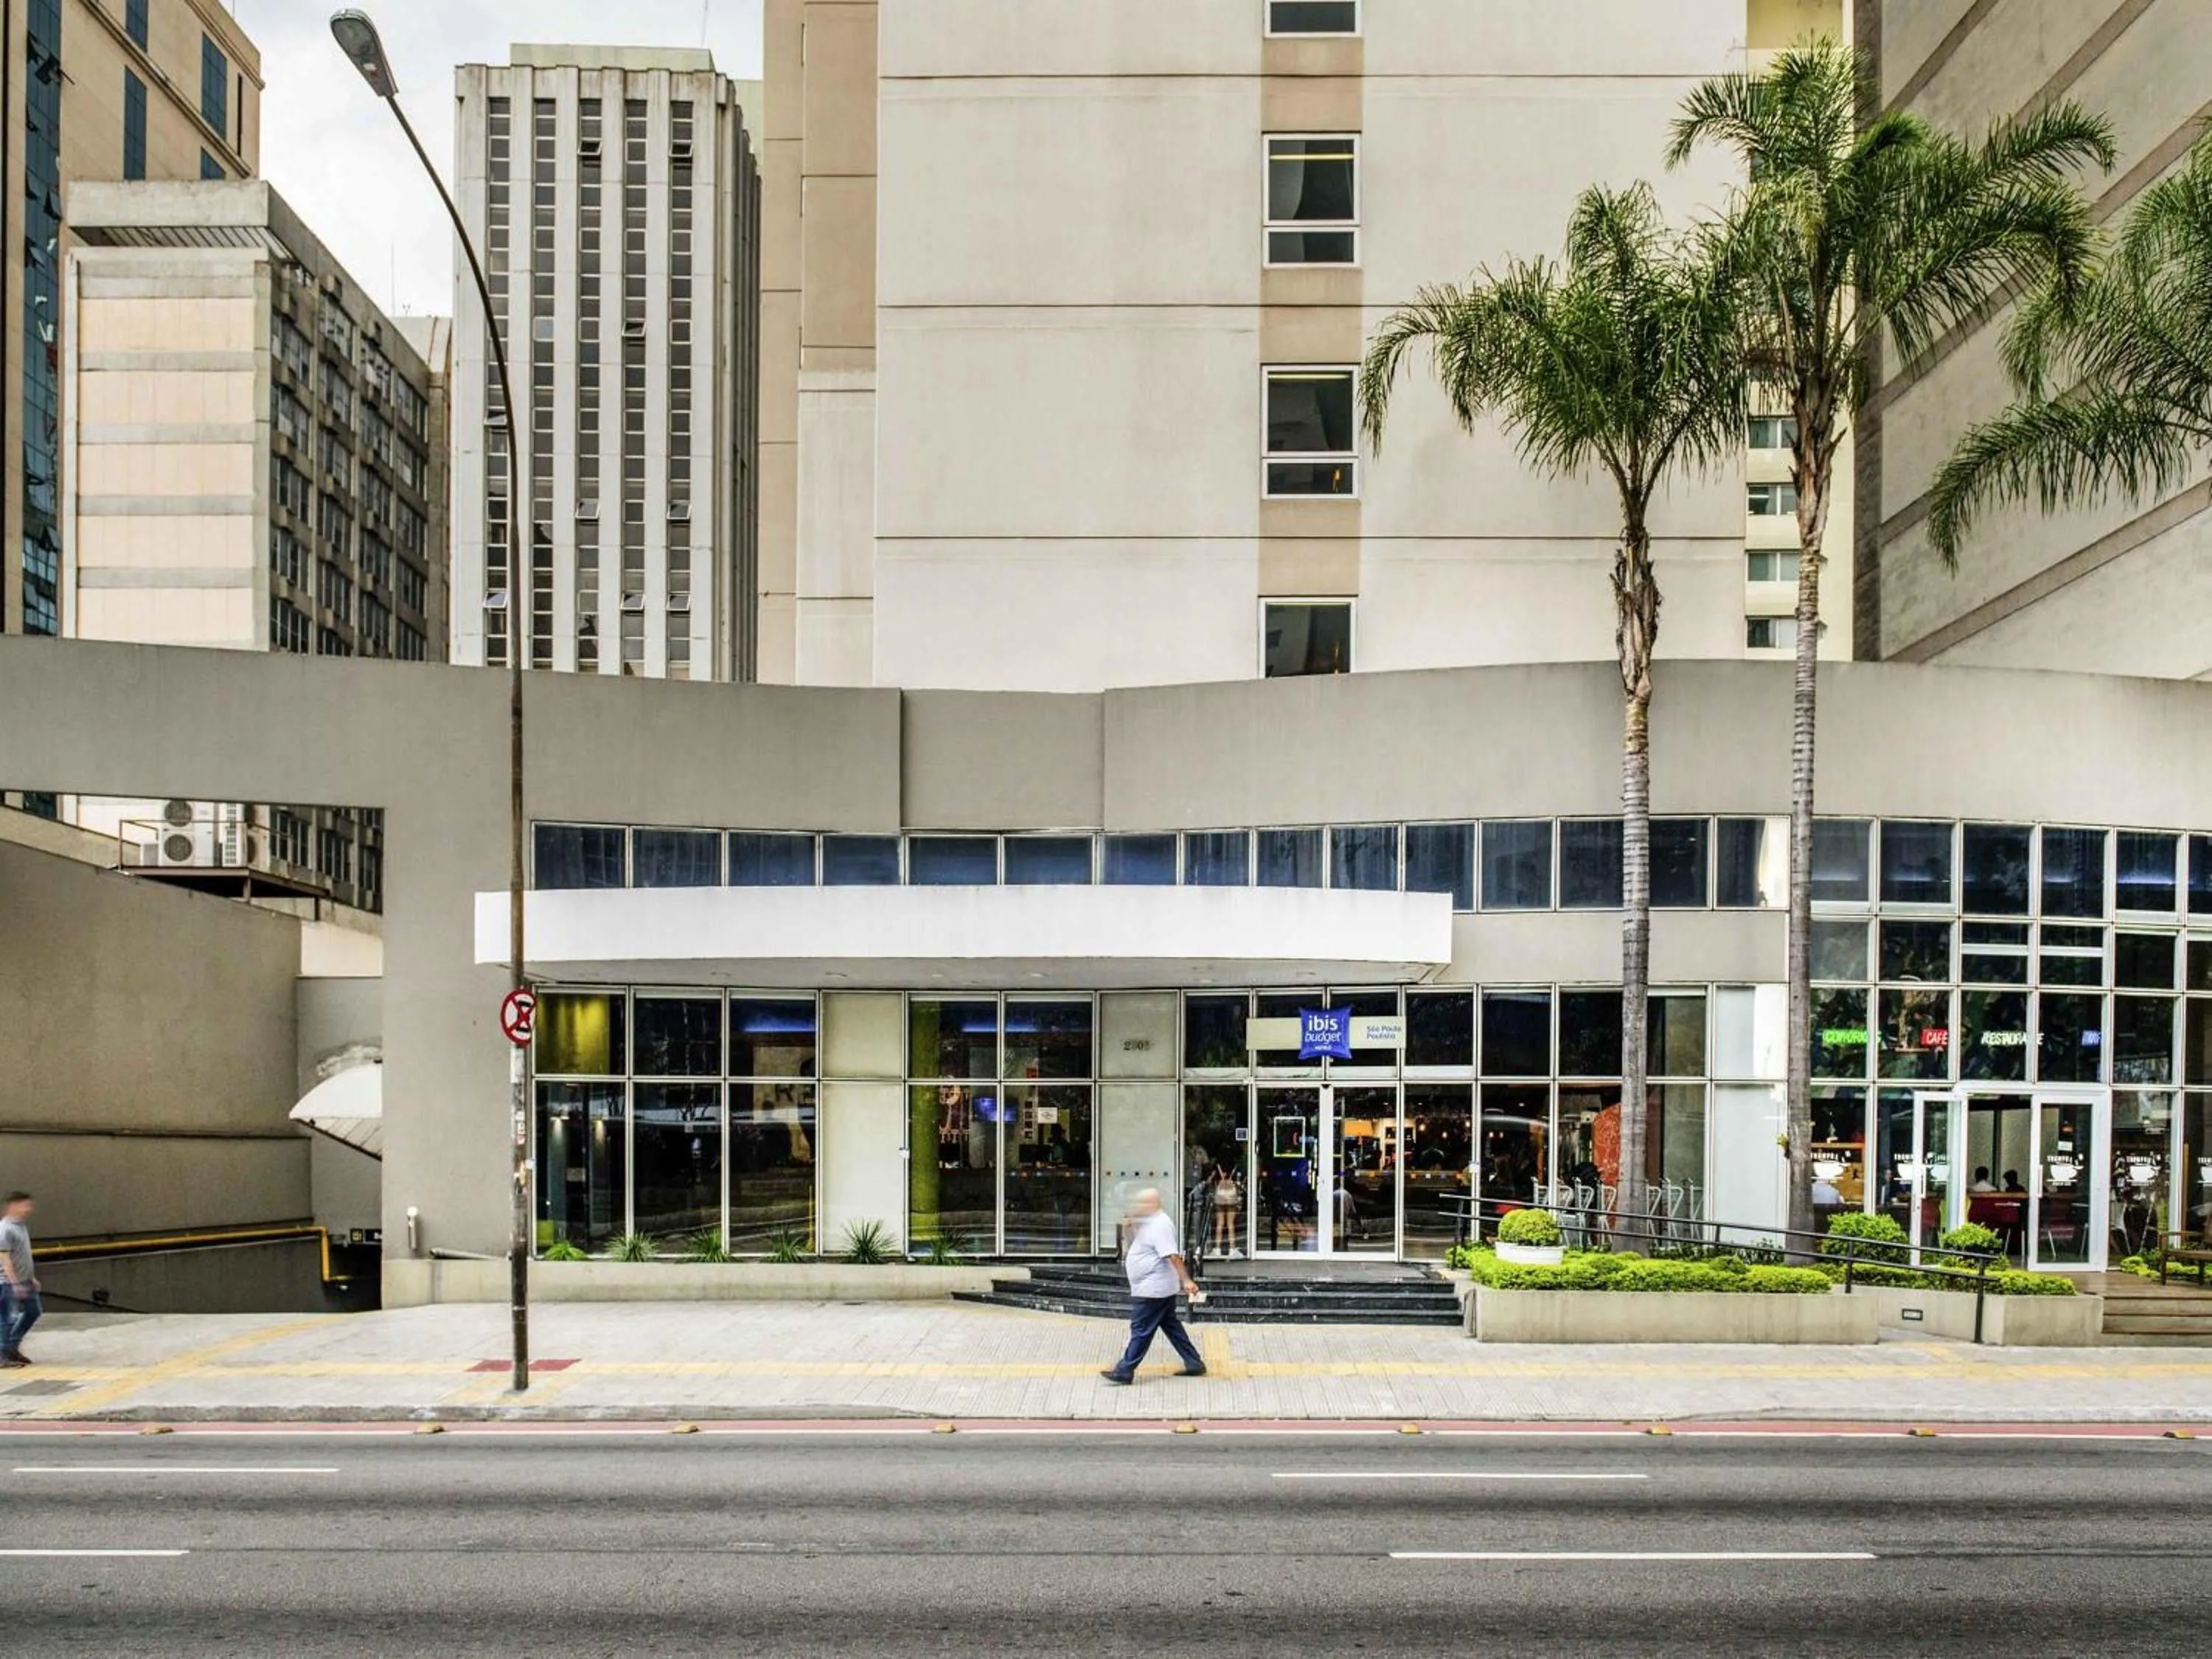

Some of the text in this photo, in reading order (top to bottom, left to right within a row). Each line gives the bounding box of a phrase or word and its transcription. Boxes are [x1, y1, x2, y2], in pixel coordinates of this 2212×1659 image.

[1309, 1015, 1338, 1031] ibis
[1304, 1031, 1341, 1044] budget
[1980, 1032, 2045, 1046] RESTAURAE
